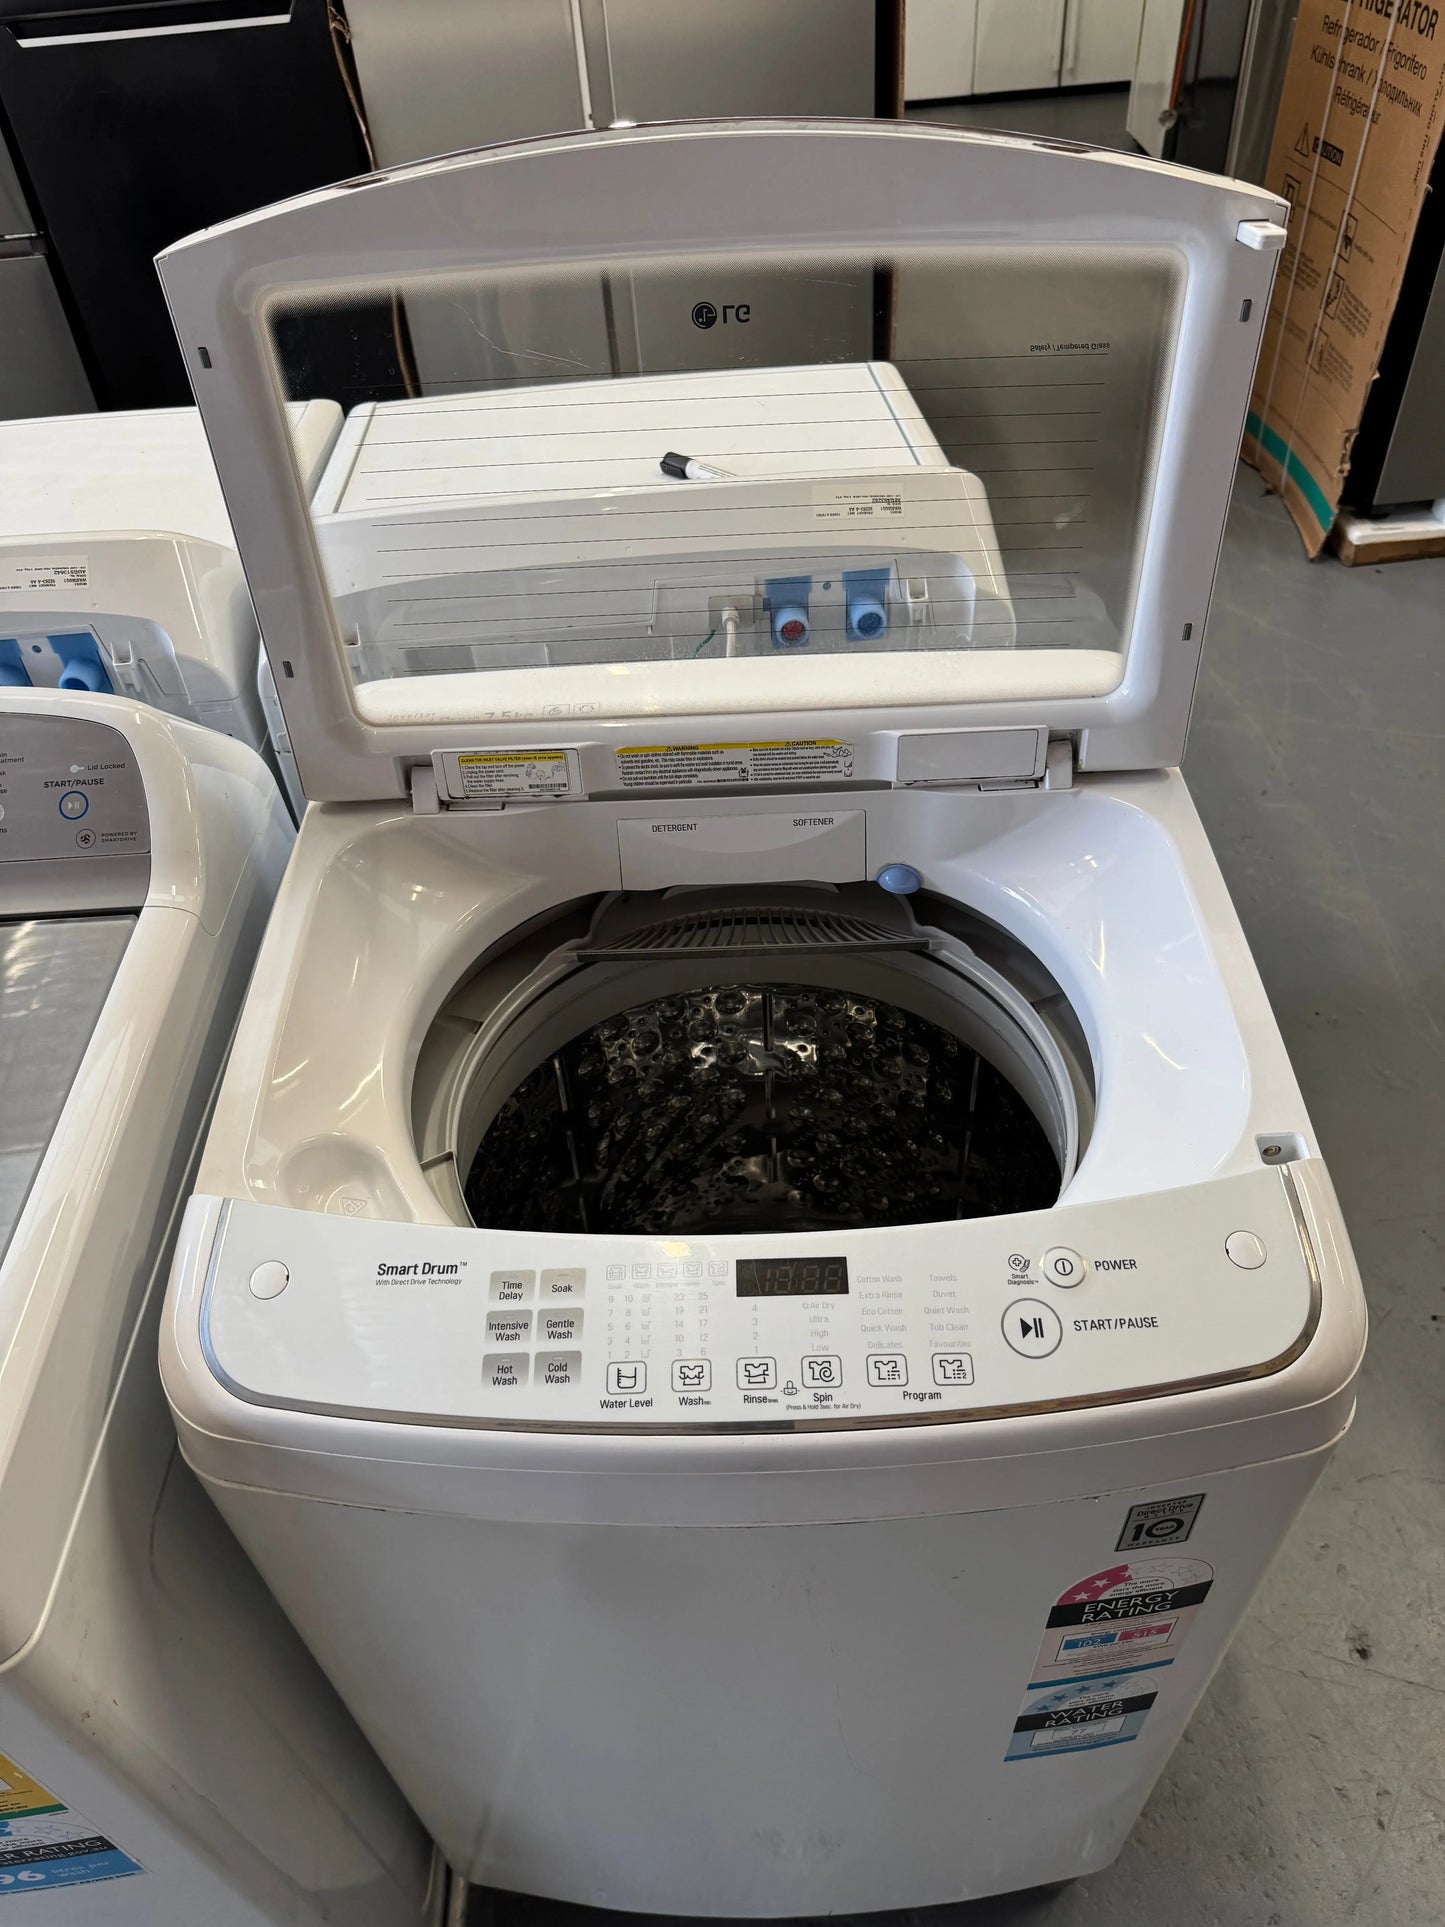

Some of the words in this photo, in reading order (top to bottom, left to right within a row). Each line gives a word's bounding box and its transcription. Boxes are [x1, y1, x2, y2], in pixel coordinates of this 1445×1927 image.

[1322, 14, 1380, 53] Refrgerador
[1311, 44, 1366, 85] Kühlshrank
[1334, 85, 1382, 125] Réfrigéraur
[1314, 139, 1342, 165] CUTION
[44, 778, 105, 788] START/PAUSE
[792, 817, 834, 827] SOFTENER
[651, 823, 698, 833] DETERGENT
[377, 1263, 419, 1276] Smart
[1094, 1258, 1138, 1271] POWER
[428, 1277, 463, 1286] Technology
[857, 1275, 880, 1283] Cotton
[881, 1274, 903, 1283] Wash
[929, 1273, 957, 1282] Towels
[502, 1281, 523, 1290] Time
[551, 1283, 574, 1293] Soak
[498, 1291, 524, 1301] Delay
[625, 1294, 634, 1303] 10
[674, 1292, 685, 1301] 23
[698, 1291, 709, 1301] 25
[859, 1291, 880, 1299] Extra
[881, 1290, 903, 1299] Rinse
[933, 1290, 957, 1298] Duvet
[699, 1305, 708, 1314] 21
[822, 1301, 835, 1310] Dry
[924, 1306, 945, 1315] Quiet
[946, 1306, 970, 1314] Wash
[861, 1307, 876, 1316] Eco
[877, 1307, 904, 1315] Cotton
[546, 1319, 575, 1329] Gentle
[675, 1320, 684, 1329] 14
[699, 1319, 708, 1328] 17
[809, 1315, 829, 1323] Ultra
[488, 1321, 529, 1331] Intensive
[860, 1324, 882, 1333] Quick
[884, 1323, 908, 1332] Wash
[929, 1323, 944, 1331] Tub
[946, 1322, 969, 1331] Clean
[1073, 1317, 1159, 1332] START/PAUSE
[495, 1332, 521, 1342] Wash
[547, 1330, 573, 1340] Wash
[675, 1334, 684, 1343] 10
[699, 1333, 709, 1342] 12
[811, 1329, 829, 1338] High
[811, 1343, 829, 1352] Low
[867, 1340, 903, 1349] Delicates
[928, 1339, 972, 1348] Favourites
[497, 1364, 513, 1374] Hot
[547, 1362, 568, 1373] Cold
[492, 1376, 518, 1386] Wash
[545, 1374, 571, 1384] Wash
[678, 1396, 704, 1406] Wash
[743, 1394, 768, 1405] Rinse
[813, 1392, 833, 1404] Spin
[902, 1391, 942, 1402] Program
[600, 1399, 627, 1409] Water
[629, 1397, 653, 1408] Level
[850, 1402, 861, 1410] Dry)
[1137, 1508, 1167, 1517] Direct
[1168, 1503, 1194, 1513] Drive
[1132, 1518, 1185, 1541] 10
[1128, 1537, 1180, 1547] WARRANTY
[1084, 1590, 1180, 1613] ENERGY
[1082, 1601, 1172, 1622] RATING
[1077, 1638, 1101, 1648] 102
[1051, 1700, 1124, 1719] WATER
[1045, 1708, 1124, 1728] RATING
[22, 1840, 102, 1857] RATING
